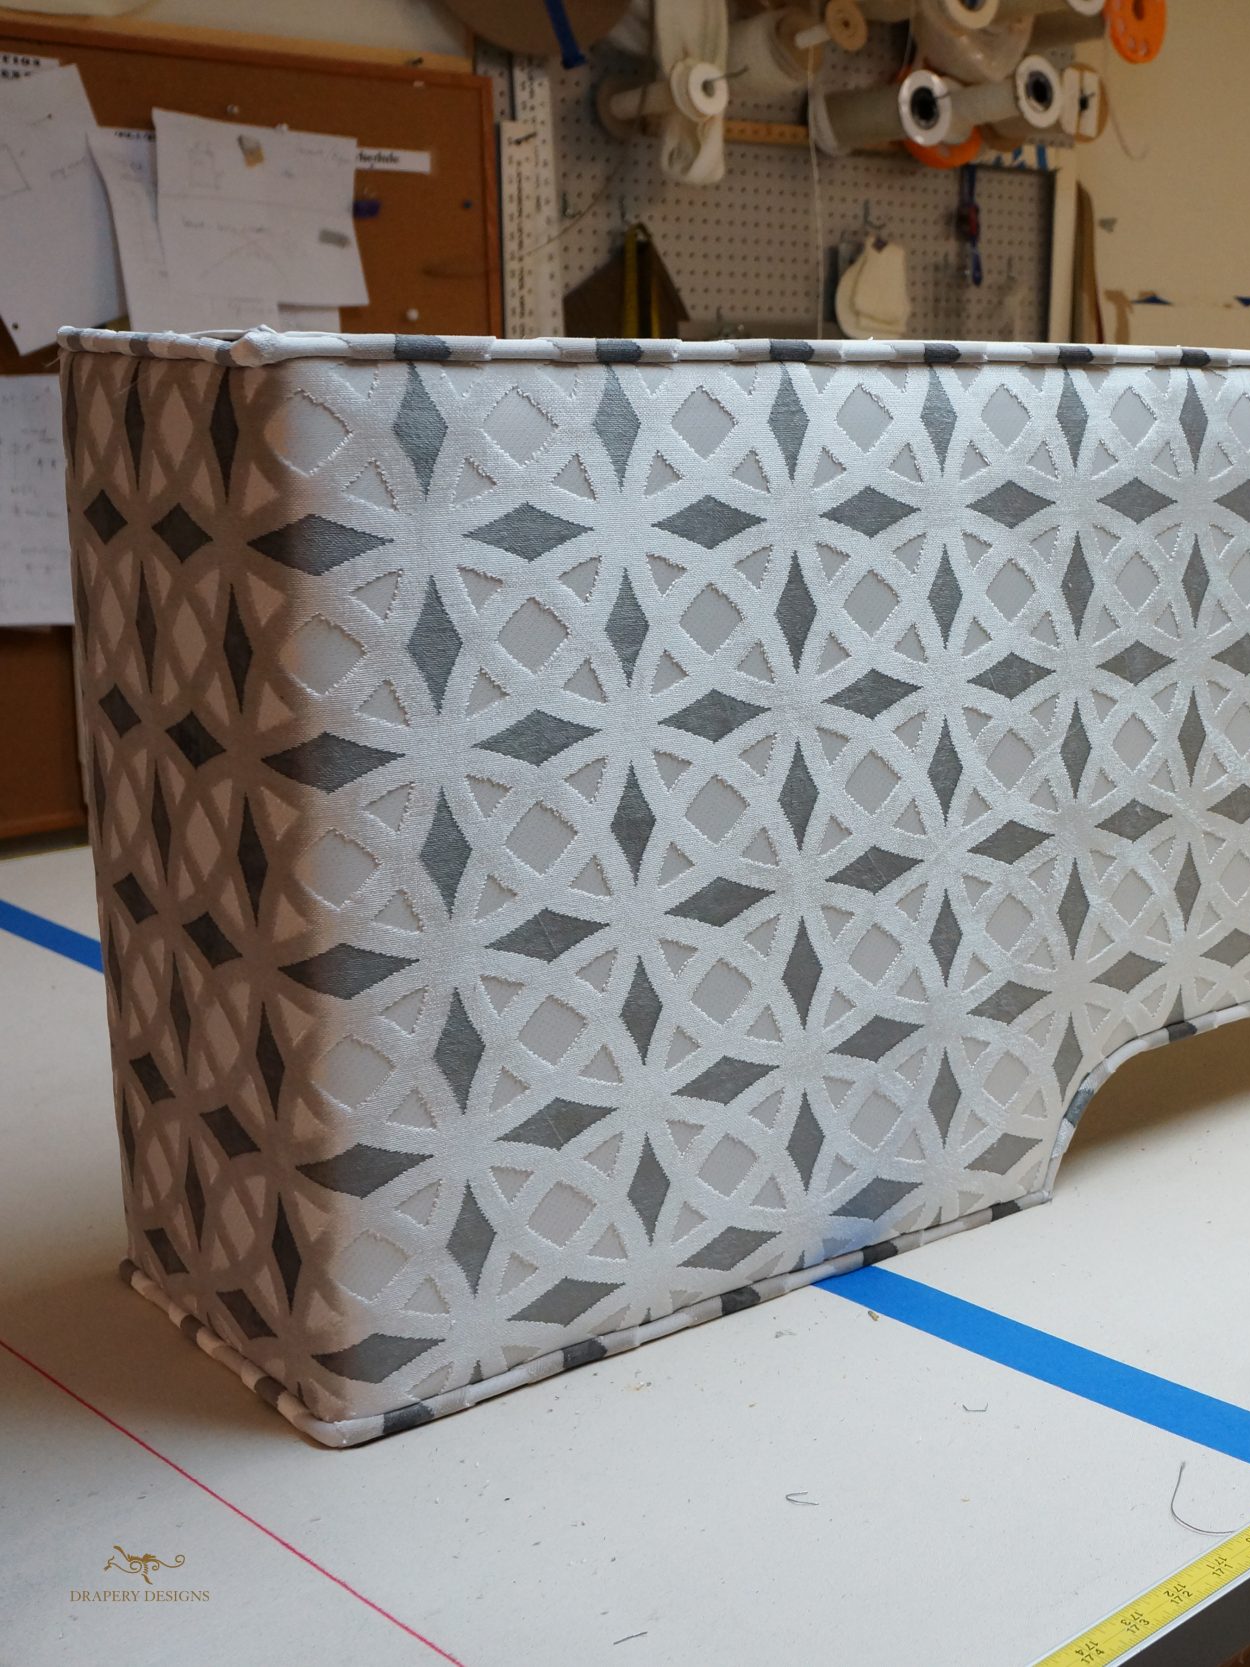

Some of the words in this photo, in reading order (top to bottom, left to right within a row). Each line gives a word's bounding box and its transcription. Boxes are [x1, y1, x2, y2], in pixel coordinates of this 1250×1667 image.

[1211, 1563, 1233, 1577] 171
[1163, 1583, 1186, 1598] 172
[1170, 1590, 1193, 1605] 172
[1120, 1611, 1143, 1626] 173
[1126, 1618, 1150, 1634] 173
[1074, 1640, 1099, 1656] 174
[1081, 1648, 1105, 1664] 174
